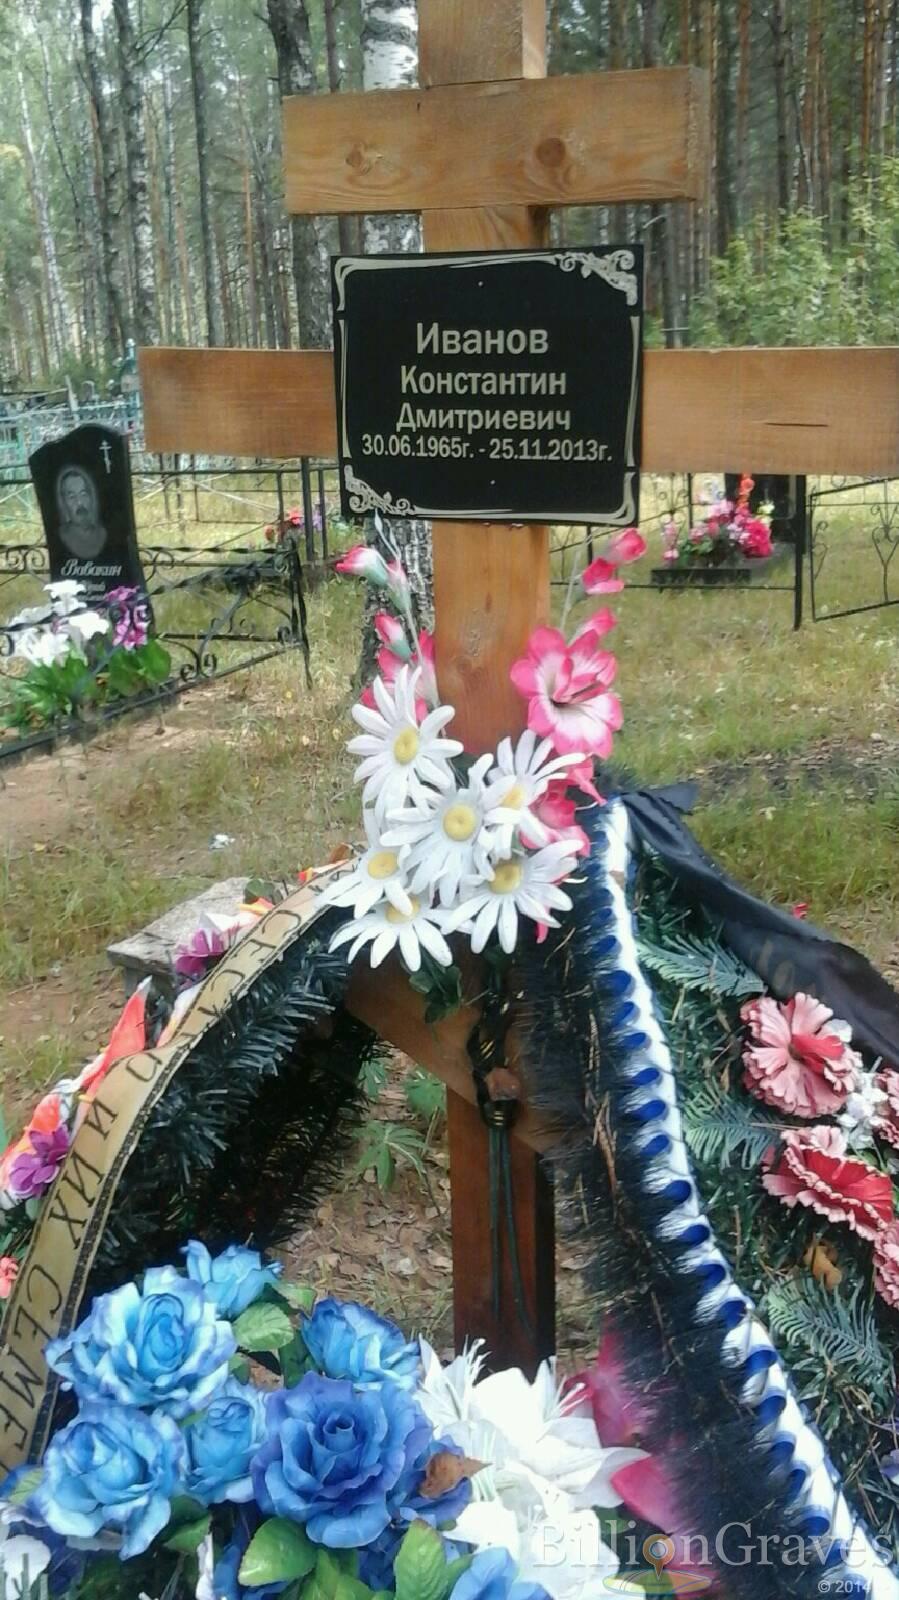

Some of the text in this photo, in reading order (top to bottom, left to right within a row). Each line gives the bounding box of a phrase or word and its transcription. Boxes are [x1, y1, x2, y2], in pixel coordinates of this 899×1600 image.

[416, 322, 550, 354] Иванов
[400, 365, 567, 395] Константин
[396, 402, 571, 434] Дмитриевич
[361, 433, 475, 459] 30.06.1965г.
[488, 438, 613, 462] 25.11.2013г.
[0, 1264, 63, 1472] СЕМЕ
